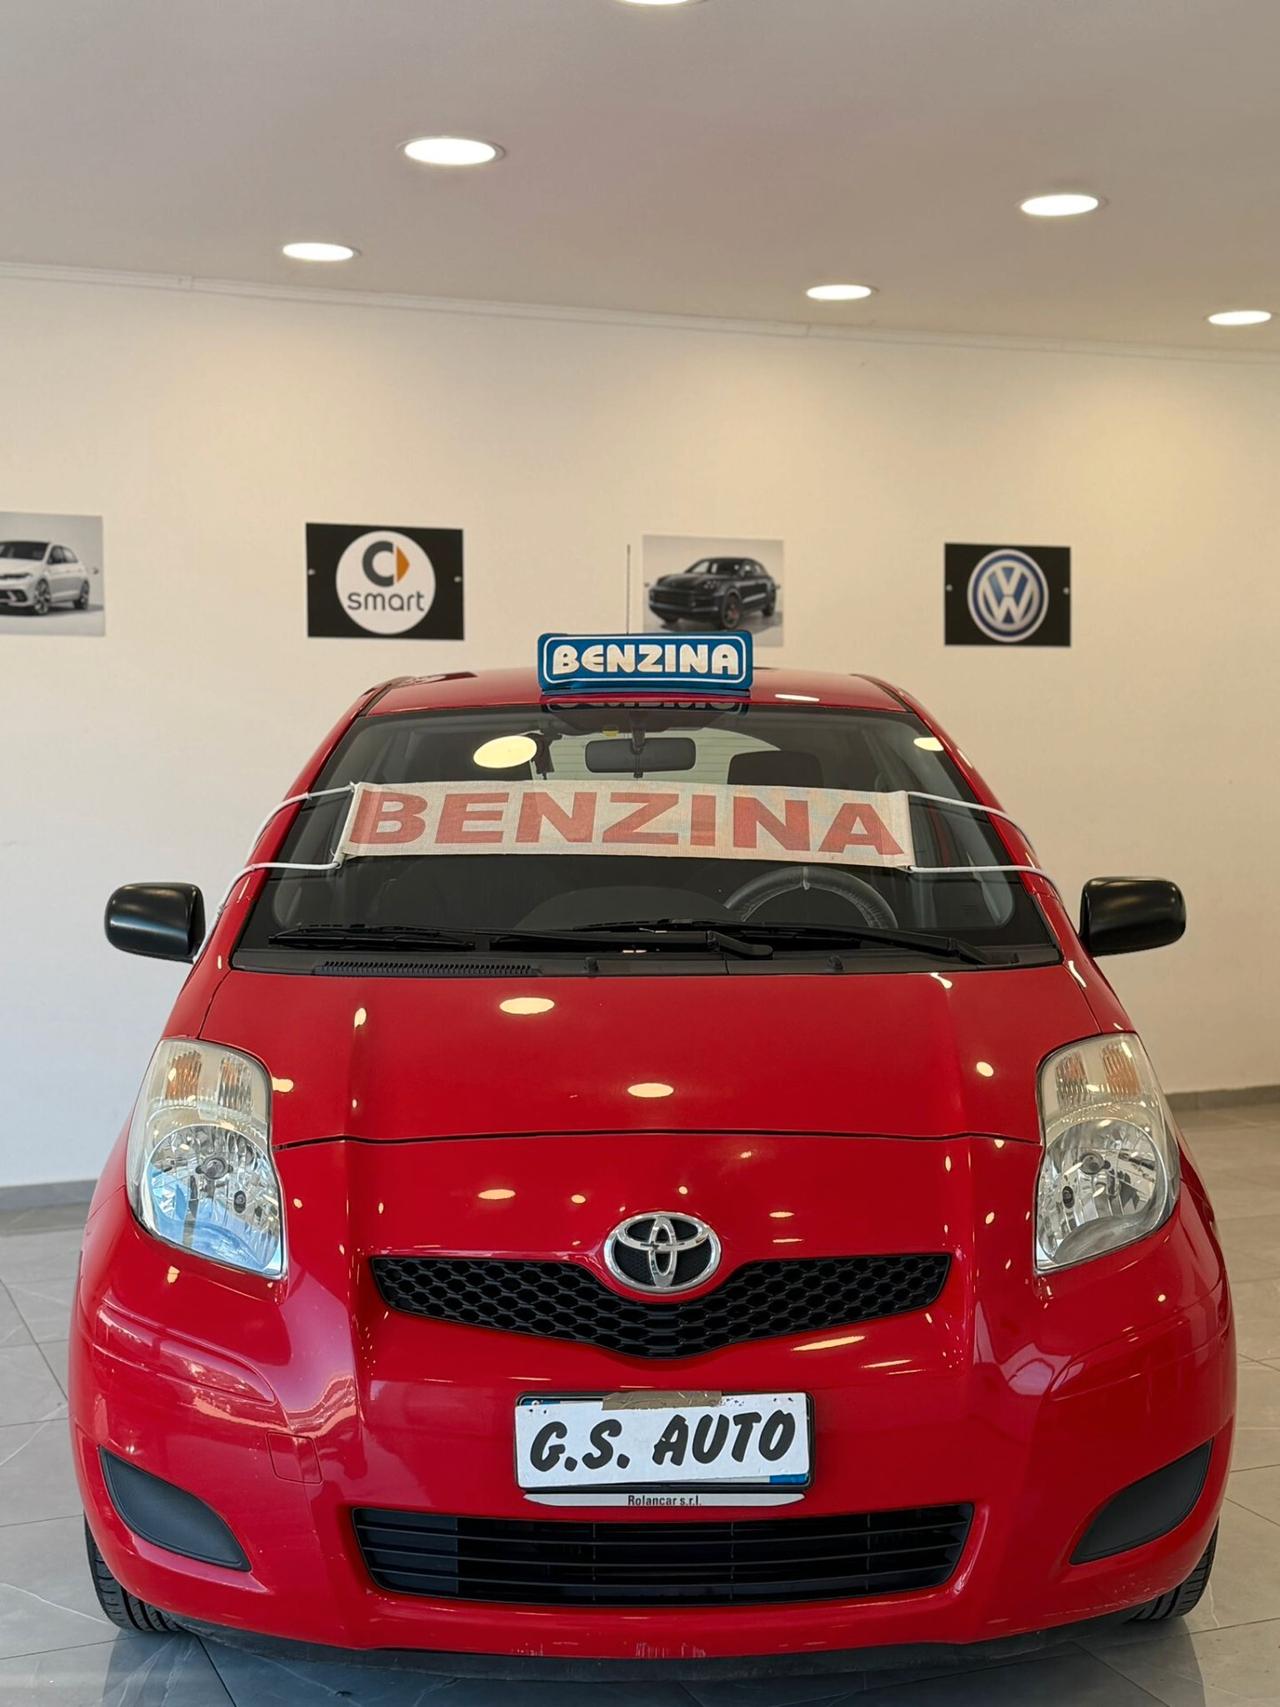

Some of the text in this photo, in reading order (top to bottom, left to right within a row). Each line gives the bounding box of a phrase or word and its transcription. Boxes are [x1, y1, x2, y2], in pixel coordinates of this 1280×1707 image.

[347, 591, 425, 612] smart
[552, 643, 740, 676] BENZINA
[348, 788, 905, 856] BENZINA
[529, 1409, 797, 1473] G.S. AUTO
[627, 1494, 703, 1506] Rolancar s.r.l.
